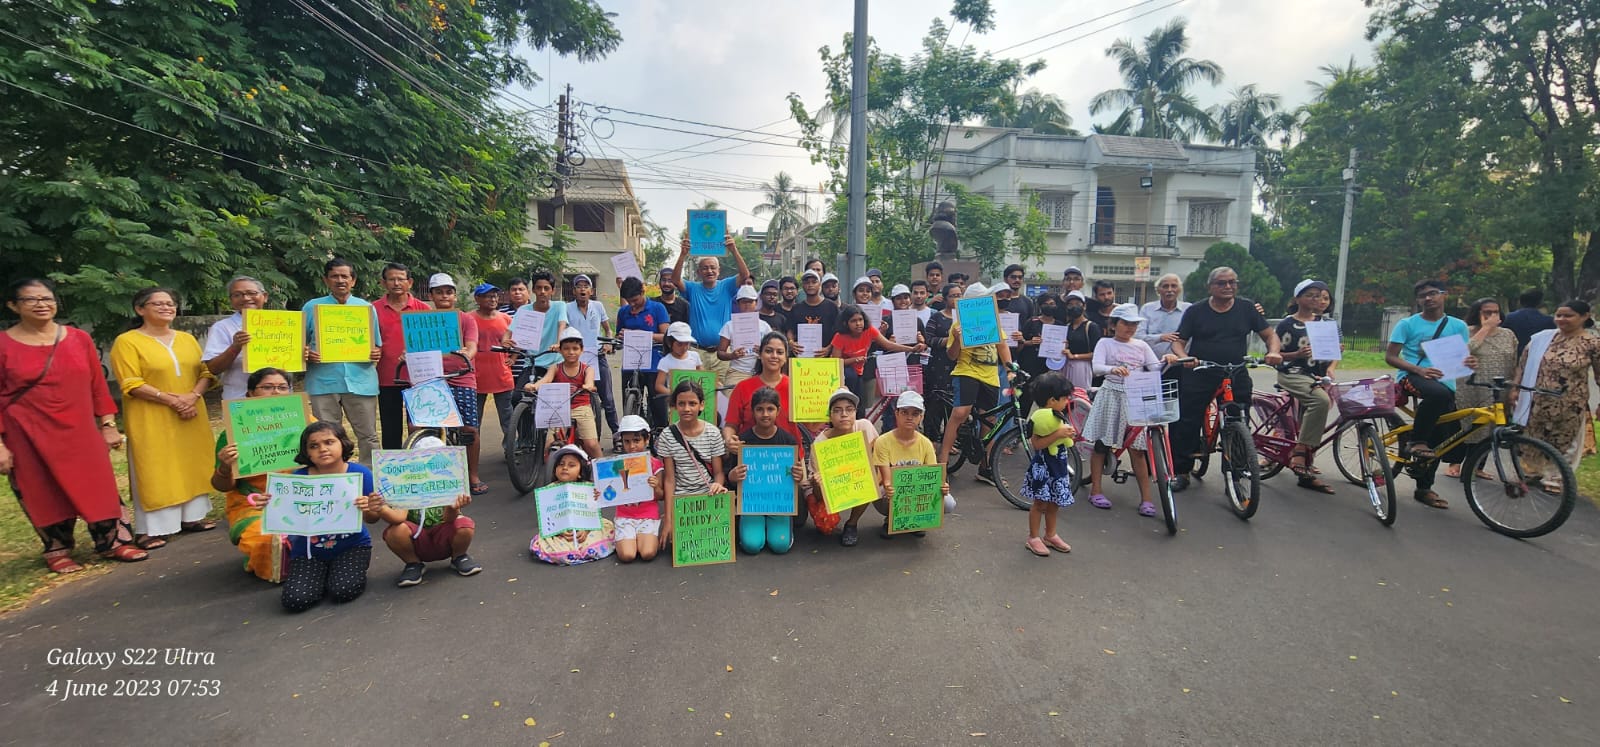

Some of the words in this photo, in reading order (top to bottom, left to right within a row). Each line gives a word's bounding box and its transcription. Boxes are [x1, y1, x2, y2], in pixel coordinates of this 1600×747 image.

[251, 313, 285, 328] Climate
[255, 329, 294, 346] Changing
[252, 344, 270, 355] Why
[252, 444, 278, 456] HAPPY
[421, 480, 459, 493] GREEN
[700, 527, 718, 539] TIME
[681, 539, 704, 551] START
